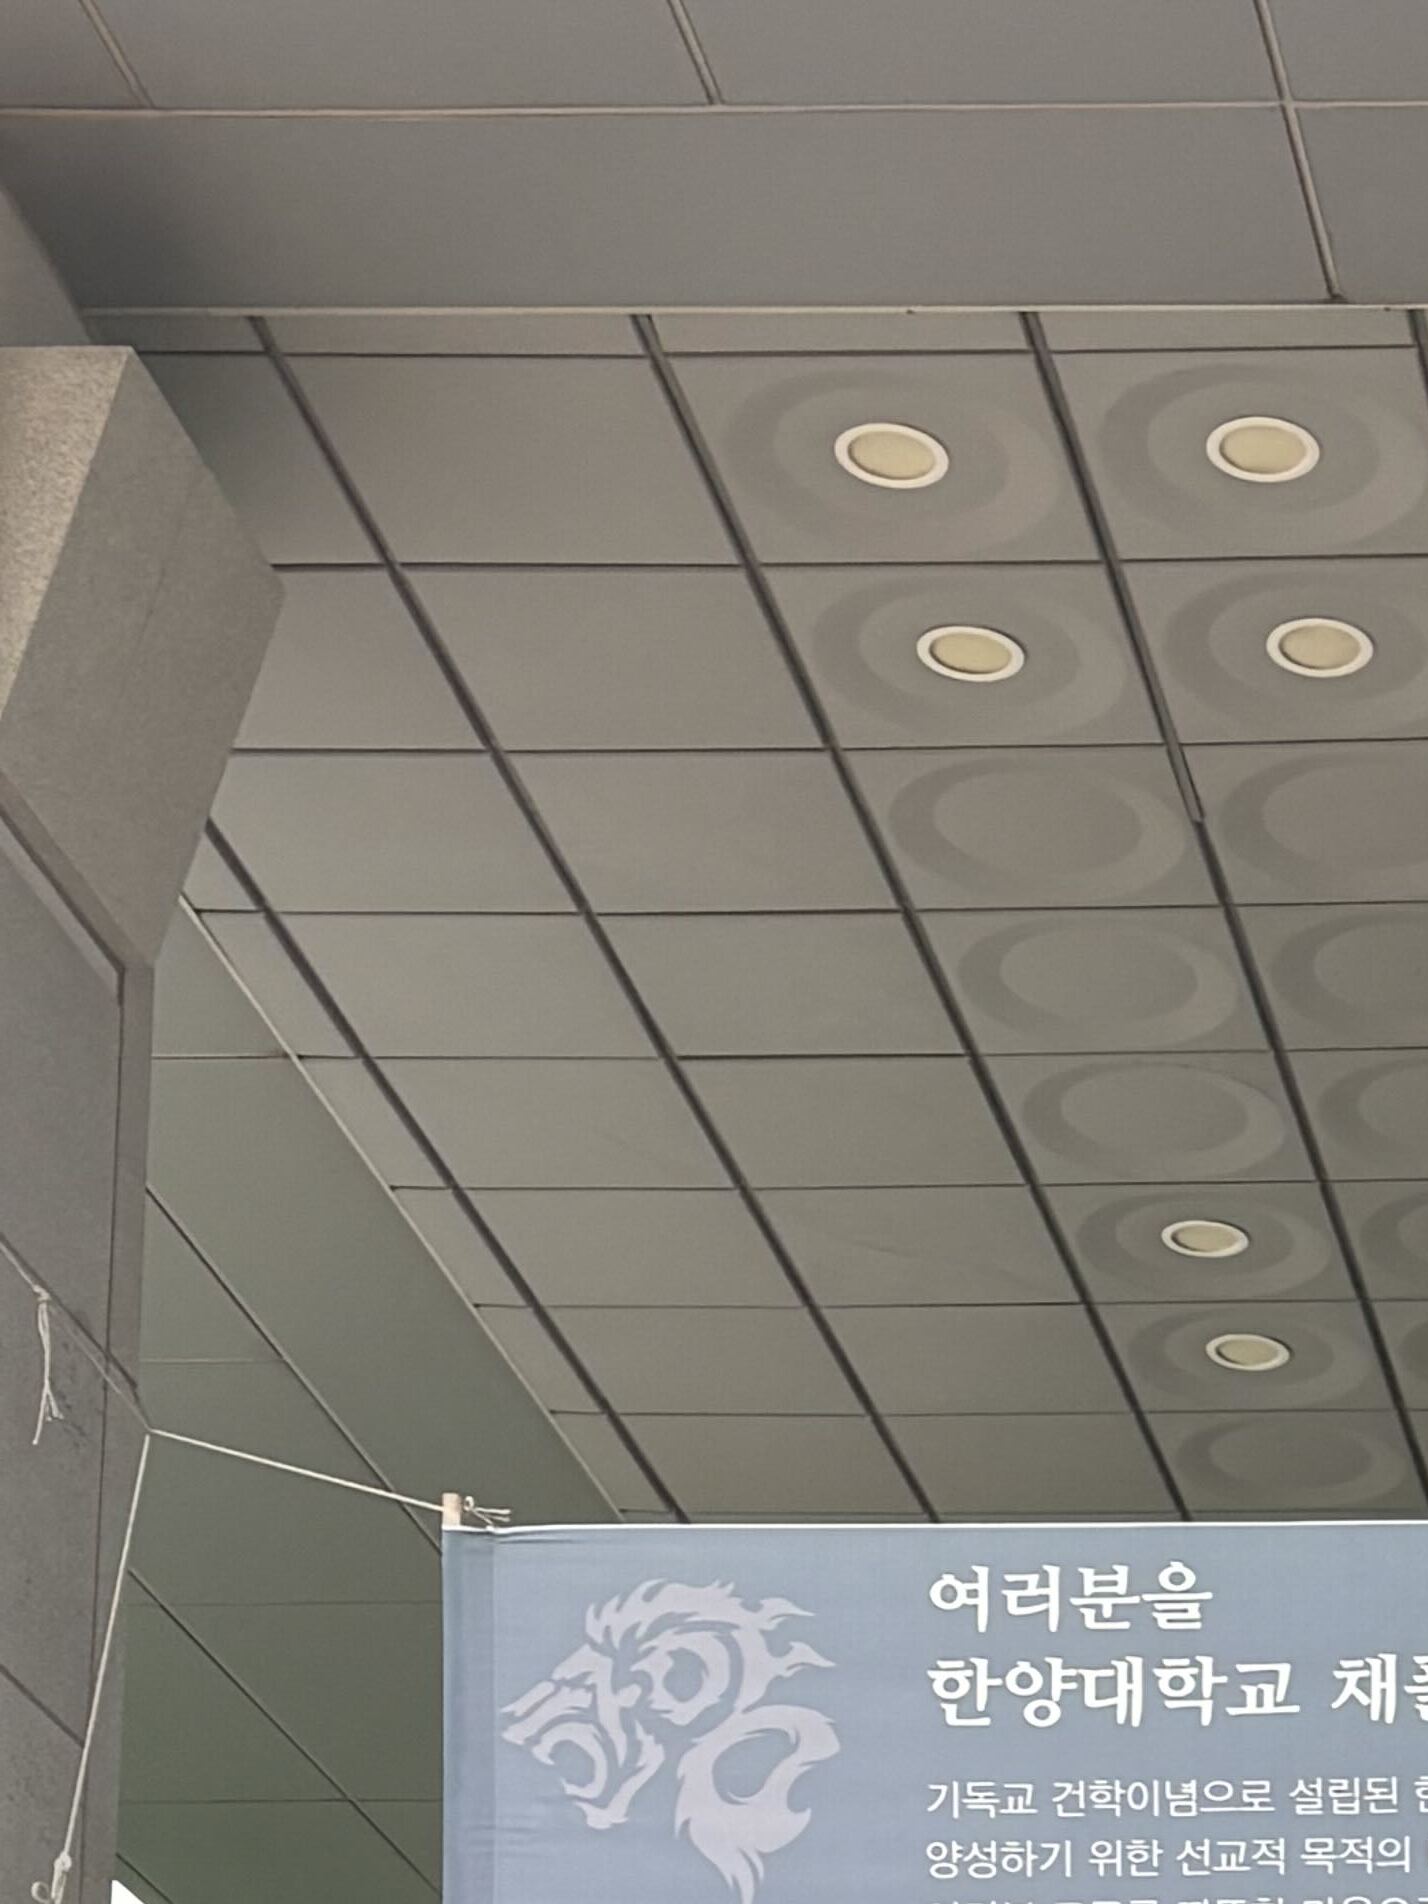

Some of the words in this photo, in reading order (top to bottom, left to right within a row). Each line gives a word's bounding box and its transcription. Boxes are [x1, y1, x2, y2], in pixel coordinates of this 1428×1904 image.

[929, 1561, 1214, 1633] 여러분을
[926, 1655, 1301, 1728] 한양대학교
[927, 1780, 1038, 1819] 기독교
[1051, 1779, 1276, 1818] 건학이념으로
[1288, 1775, 1398, 1816] 설립된
[926, 1839, 1072, 1879] 양성하기
[1088, 1839, 1164, 1877] 위한
[1176, 1837, 1285, 1876] 선교적
[1300, 1835, 1411, 1875] 목적의
